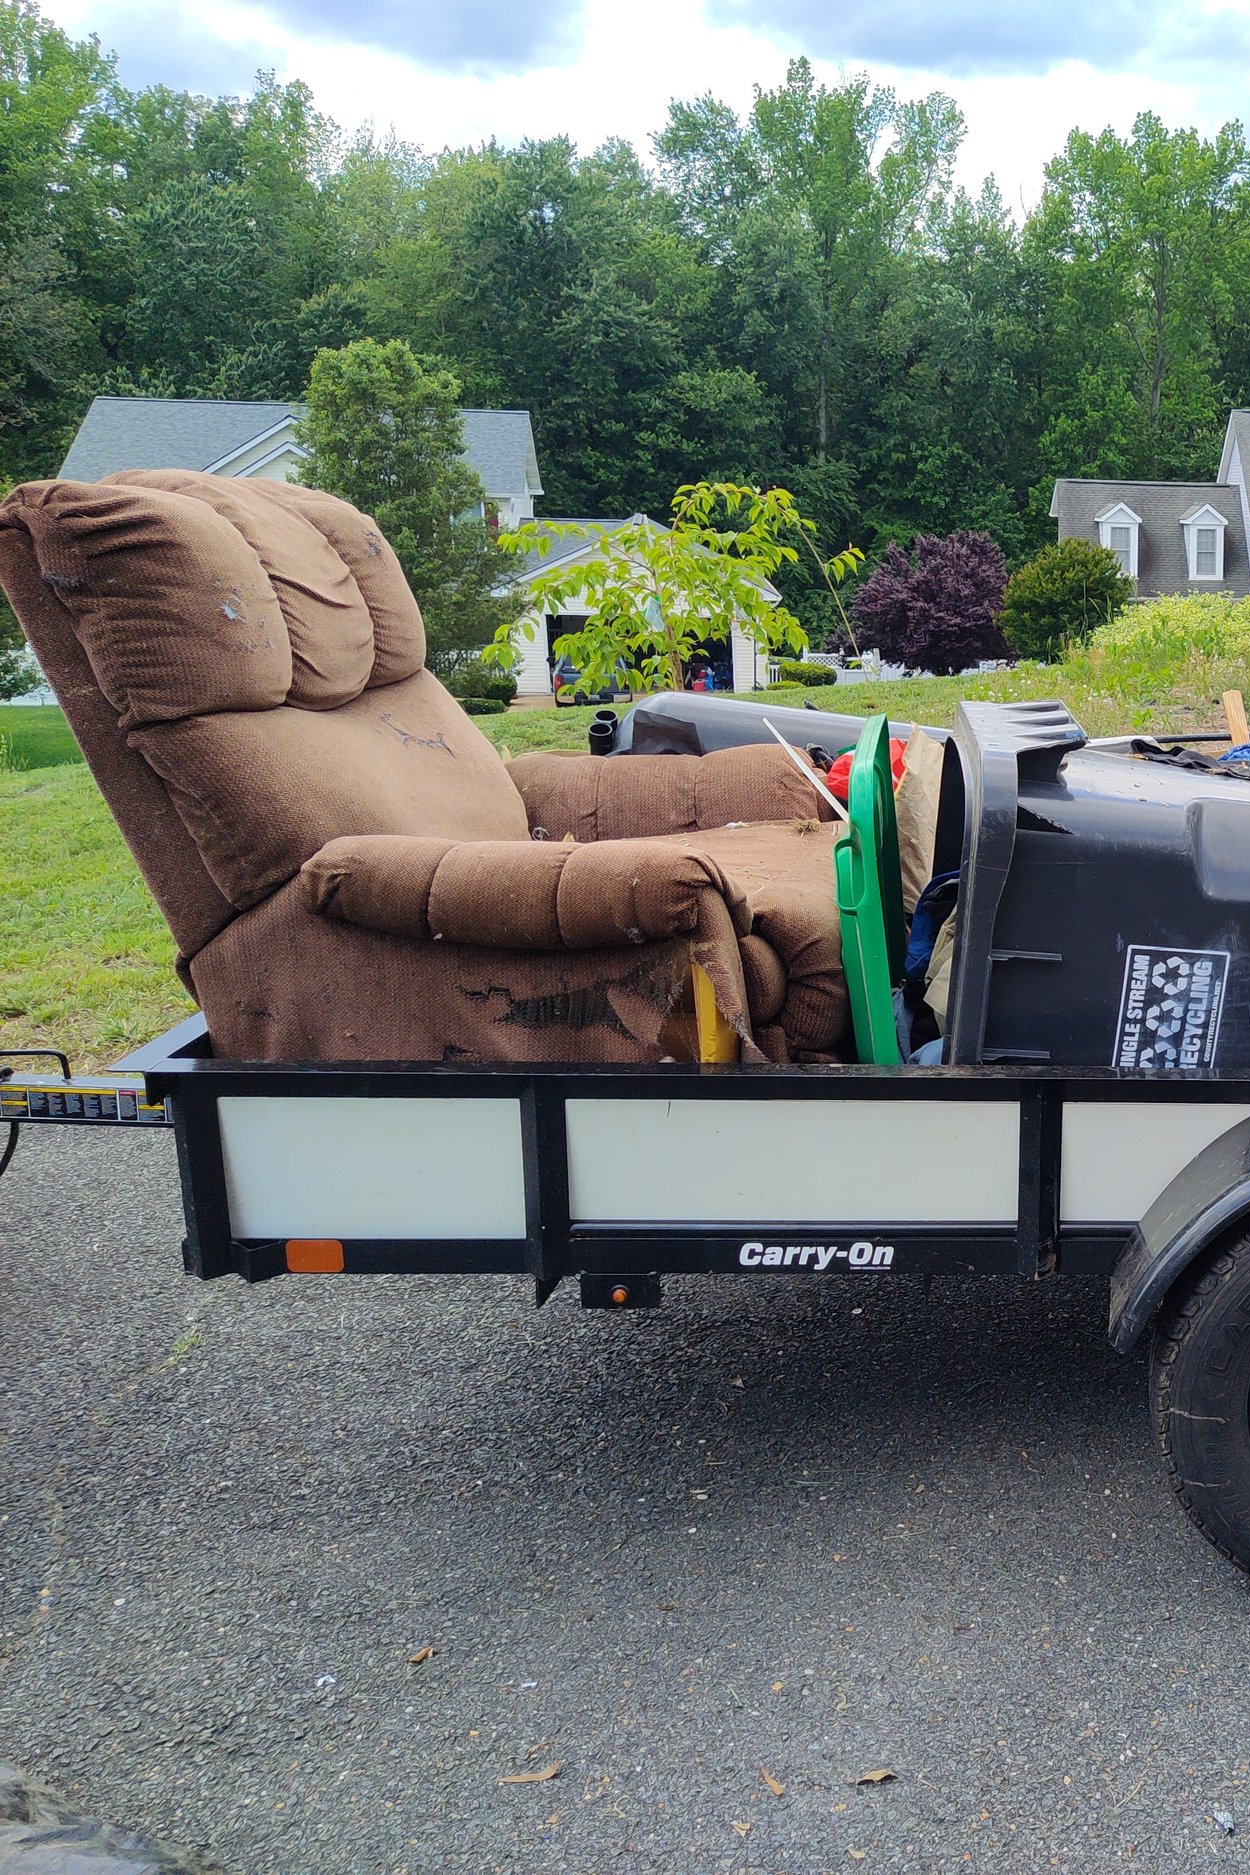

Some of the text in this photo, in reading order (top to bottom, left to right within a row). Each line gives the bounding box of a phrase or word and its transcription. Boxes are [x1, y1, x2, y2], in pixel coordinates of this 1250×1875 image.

[1120, 955, 1150, 1067] INGLE STREAM
[739, 1242, 894, 1270] Carry-On
